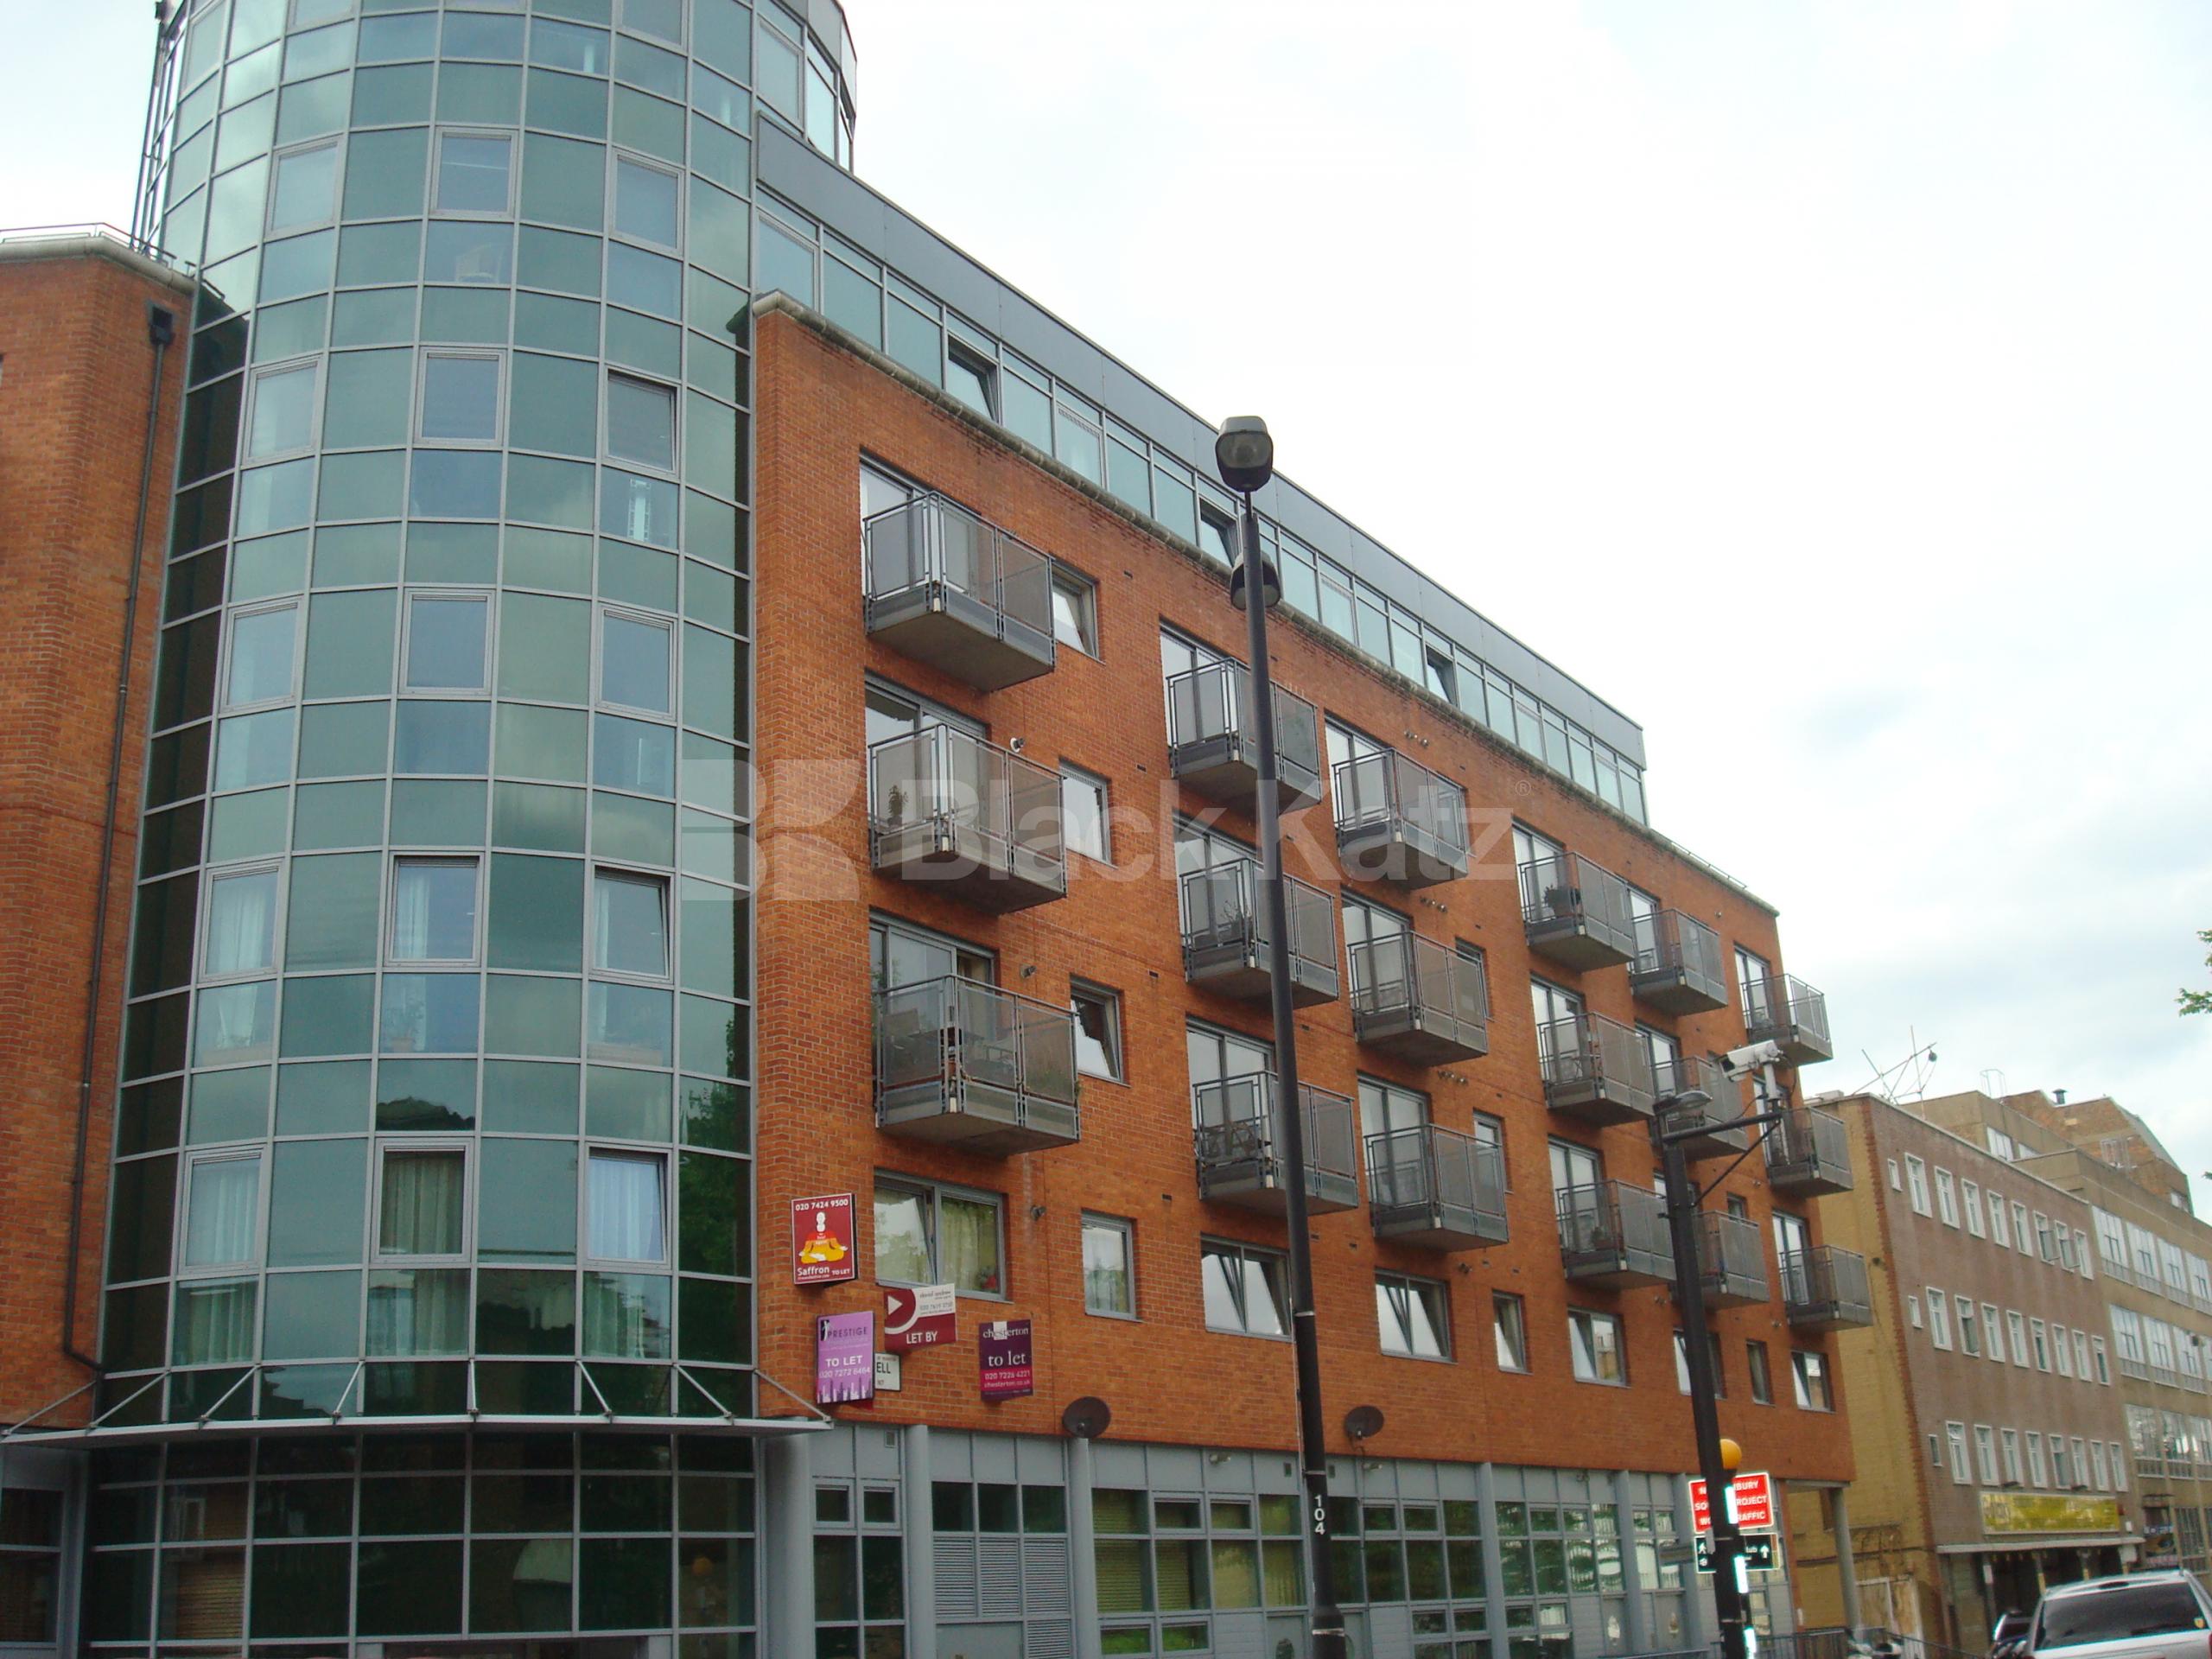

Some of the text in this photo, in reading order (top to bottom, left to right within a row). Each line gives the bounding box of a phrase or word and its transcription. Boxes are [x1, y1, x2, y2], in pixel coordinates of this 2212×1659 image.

[811, 1201, 830, 1210] 7424
[797, 1266, 830, 1276] Saffron
[828, 1326, 868, 1338] PRESTIGE
[906, 1331, 938, 1344] LET BY
[982, 1327, 1029, 1338] chesterton
[825, 1355, 863, 1368] TO LET
[988, 1351, 1027, 1367] to let
[876, 1362, 892, 1374] ELL
[984, 1372, 998, 1381] 020
[1733, 1479, 1759, 1492] BURY
[1735, 1494, 1768, 1506] ROJECT
[1313, 1494, 1326, 1535] 104
[1737, 1510, 1766, 1522] RAFFIC
